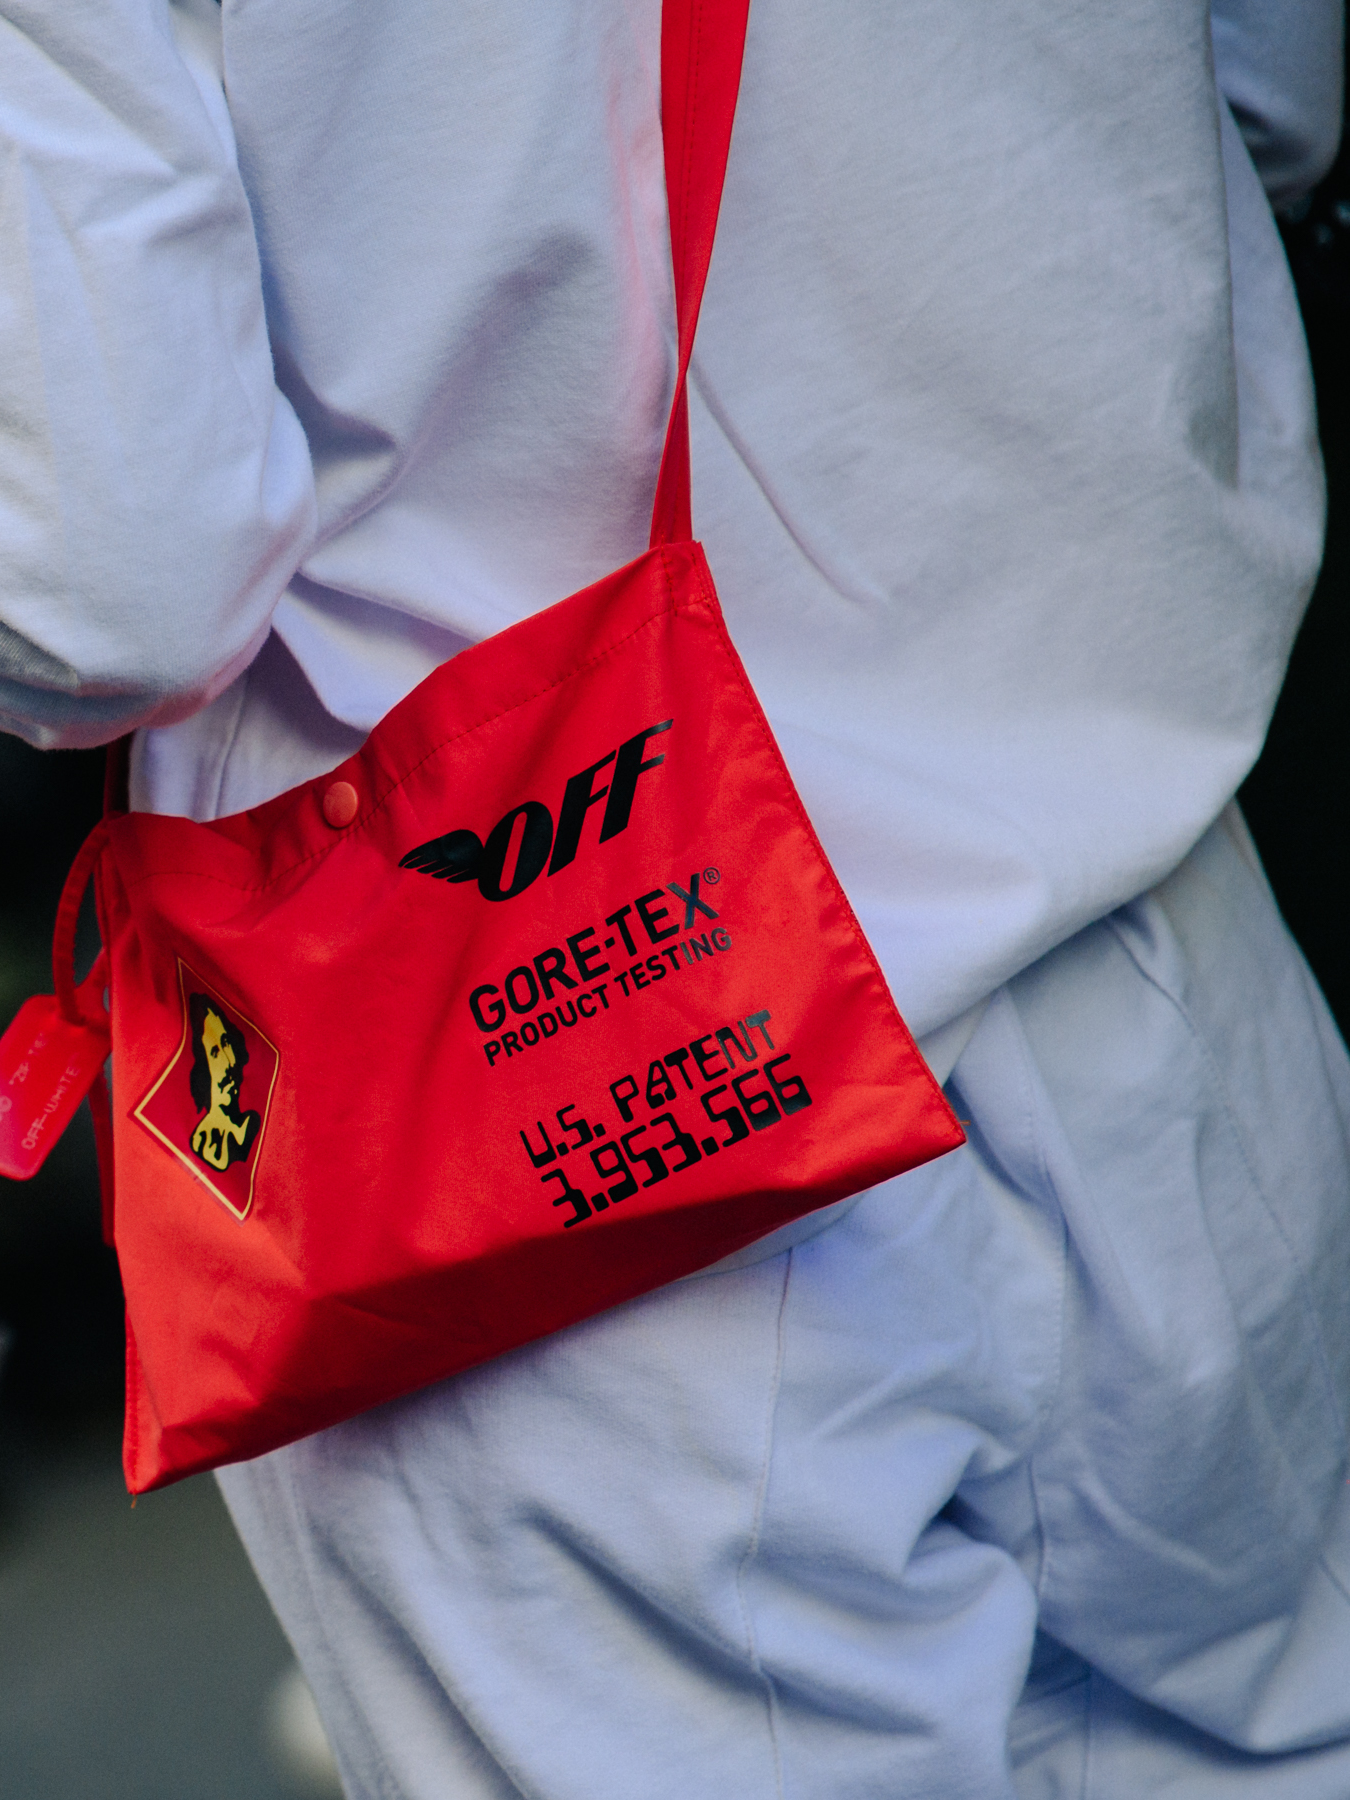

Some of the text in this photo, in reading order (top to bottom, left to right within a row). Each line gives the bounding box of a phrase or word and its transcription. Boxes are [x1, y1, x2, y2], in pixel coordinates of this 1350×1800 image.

[477, 718, 675, 903] OFF
[482, 926, 733, 1067] PRODUCT TESTING
[518, 1008, 773, 1169] U.S. PATENT
[539, 1052, 814, 1229] 3.953.566
